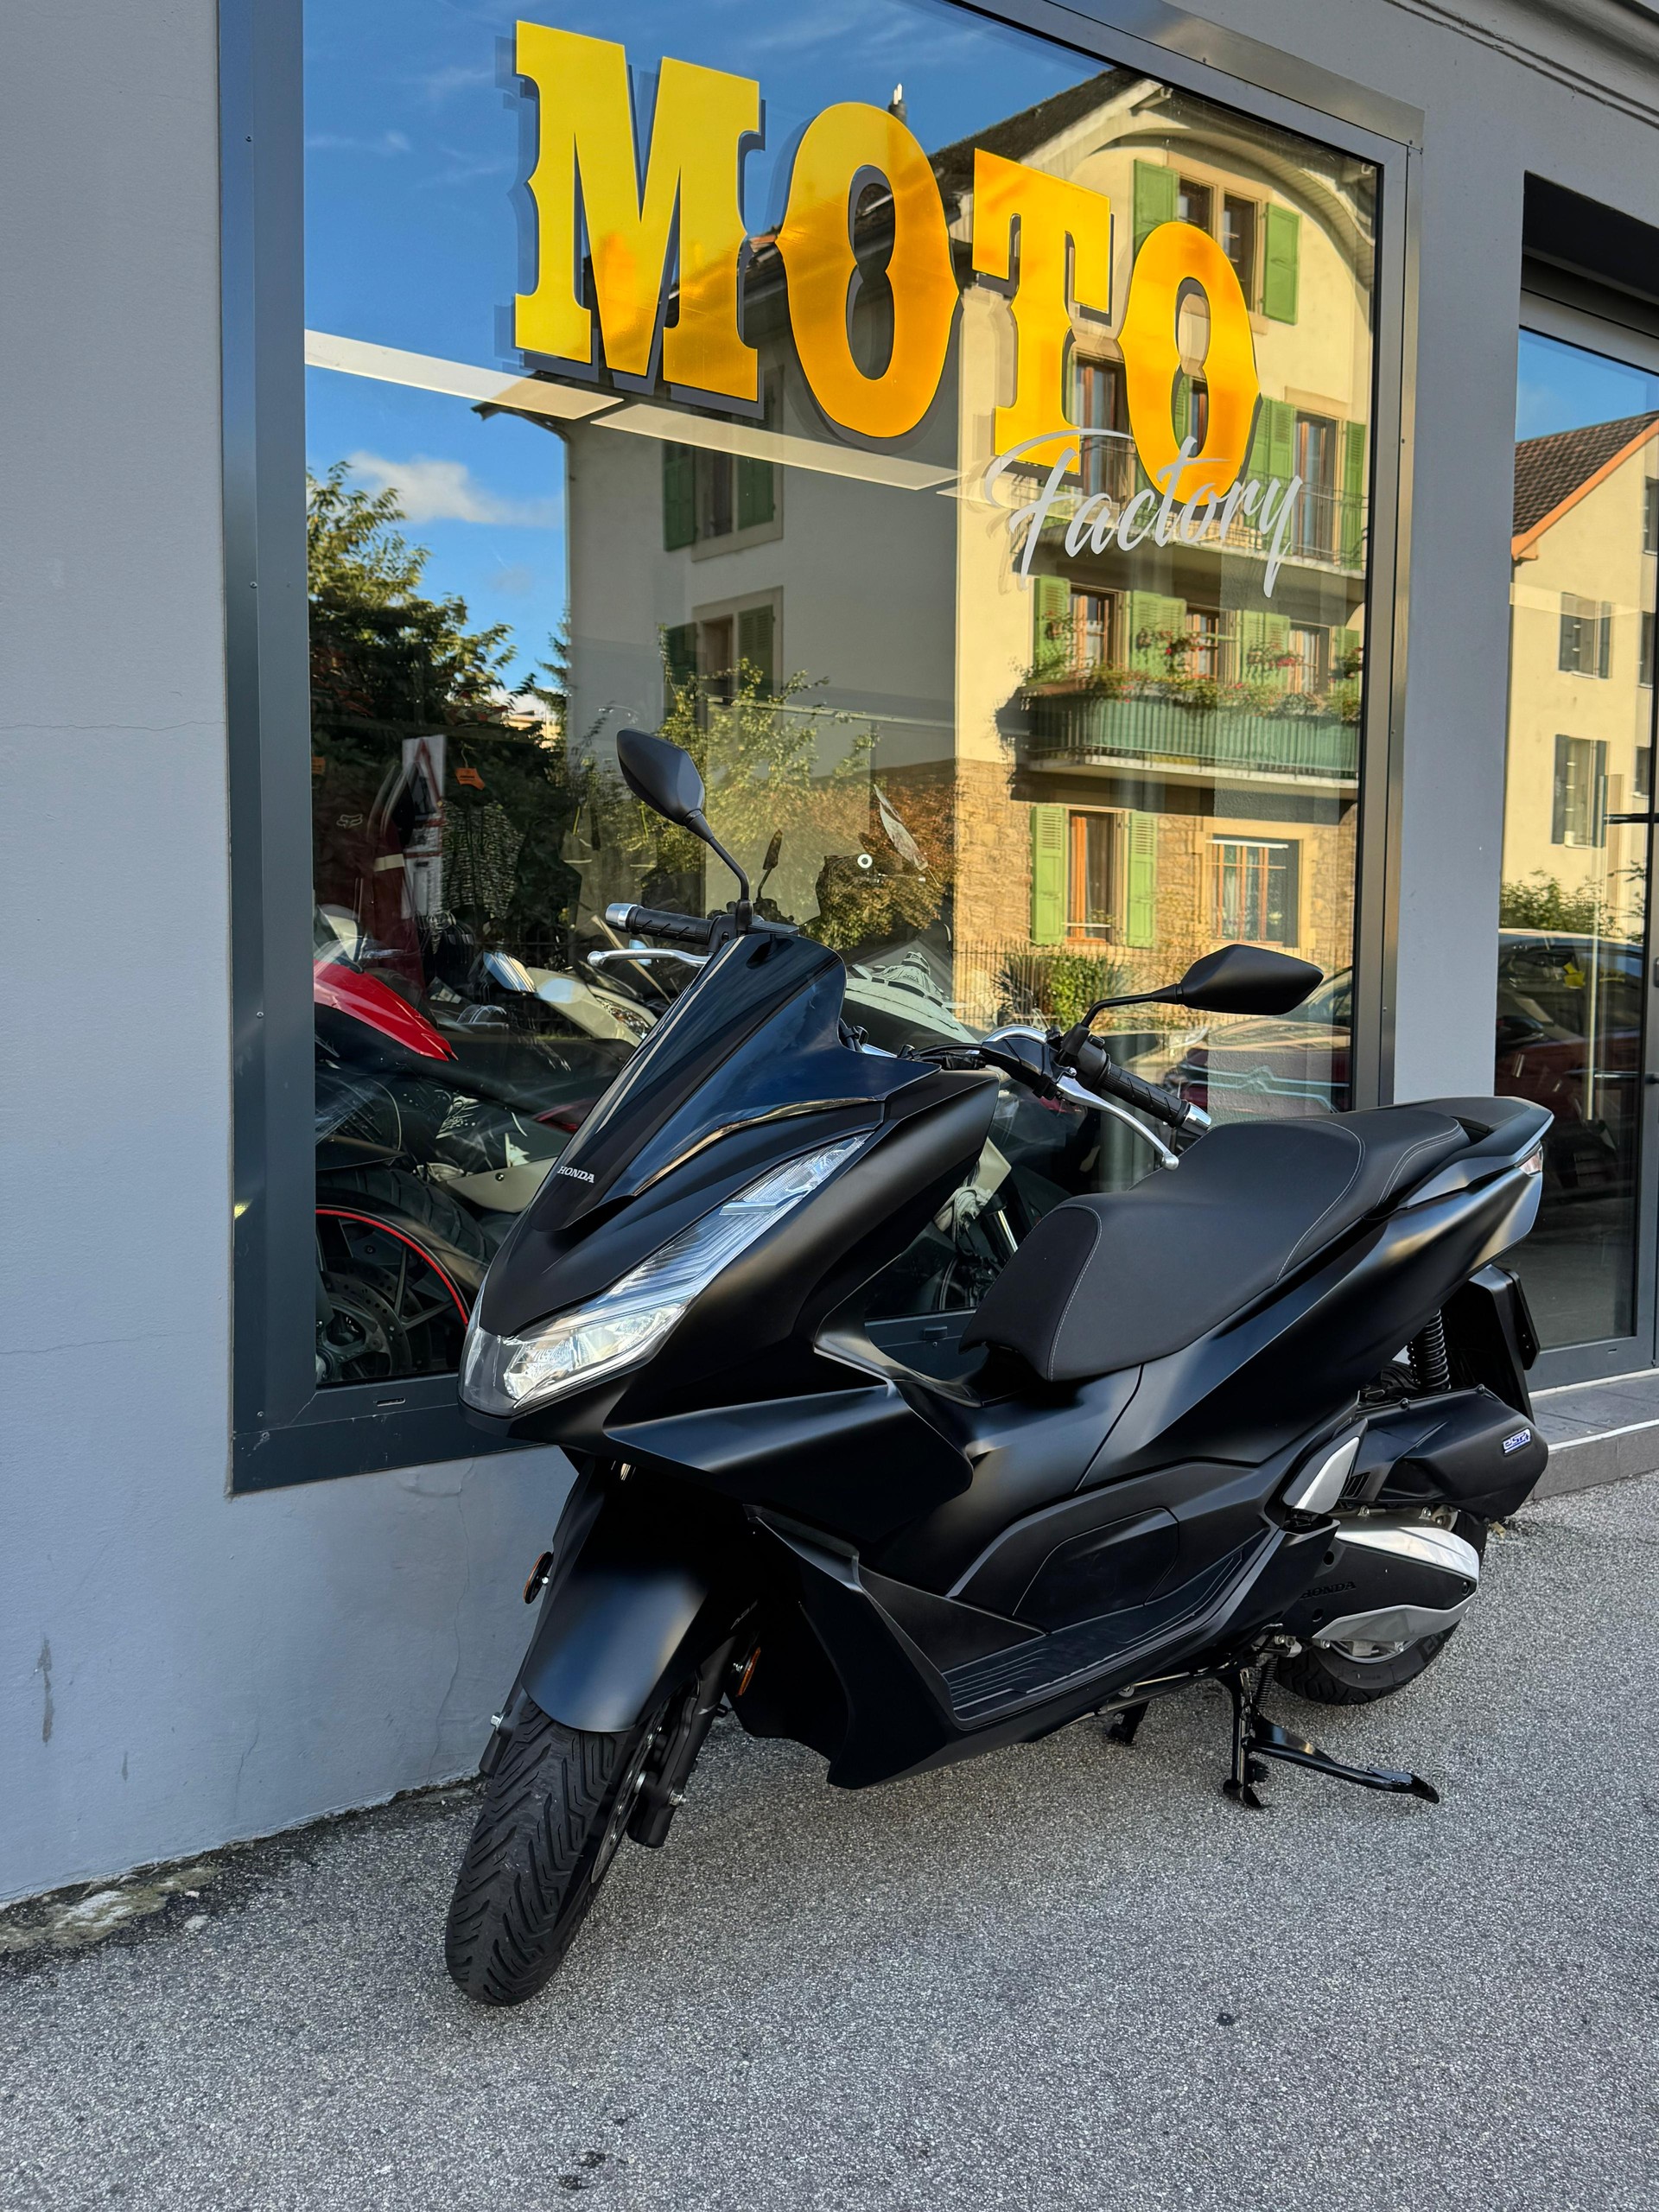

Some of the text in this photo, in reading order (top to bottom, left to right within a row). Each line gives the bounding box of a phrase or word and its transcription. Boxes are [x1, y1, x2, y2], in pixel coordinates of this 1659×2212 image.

[514, 19, 1261, 506] MOTO
[985, 429, 1303, 599] Factory
[557, 1166, 594, 1184] HONDA
